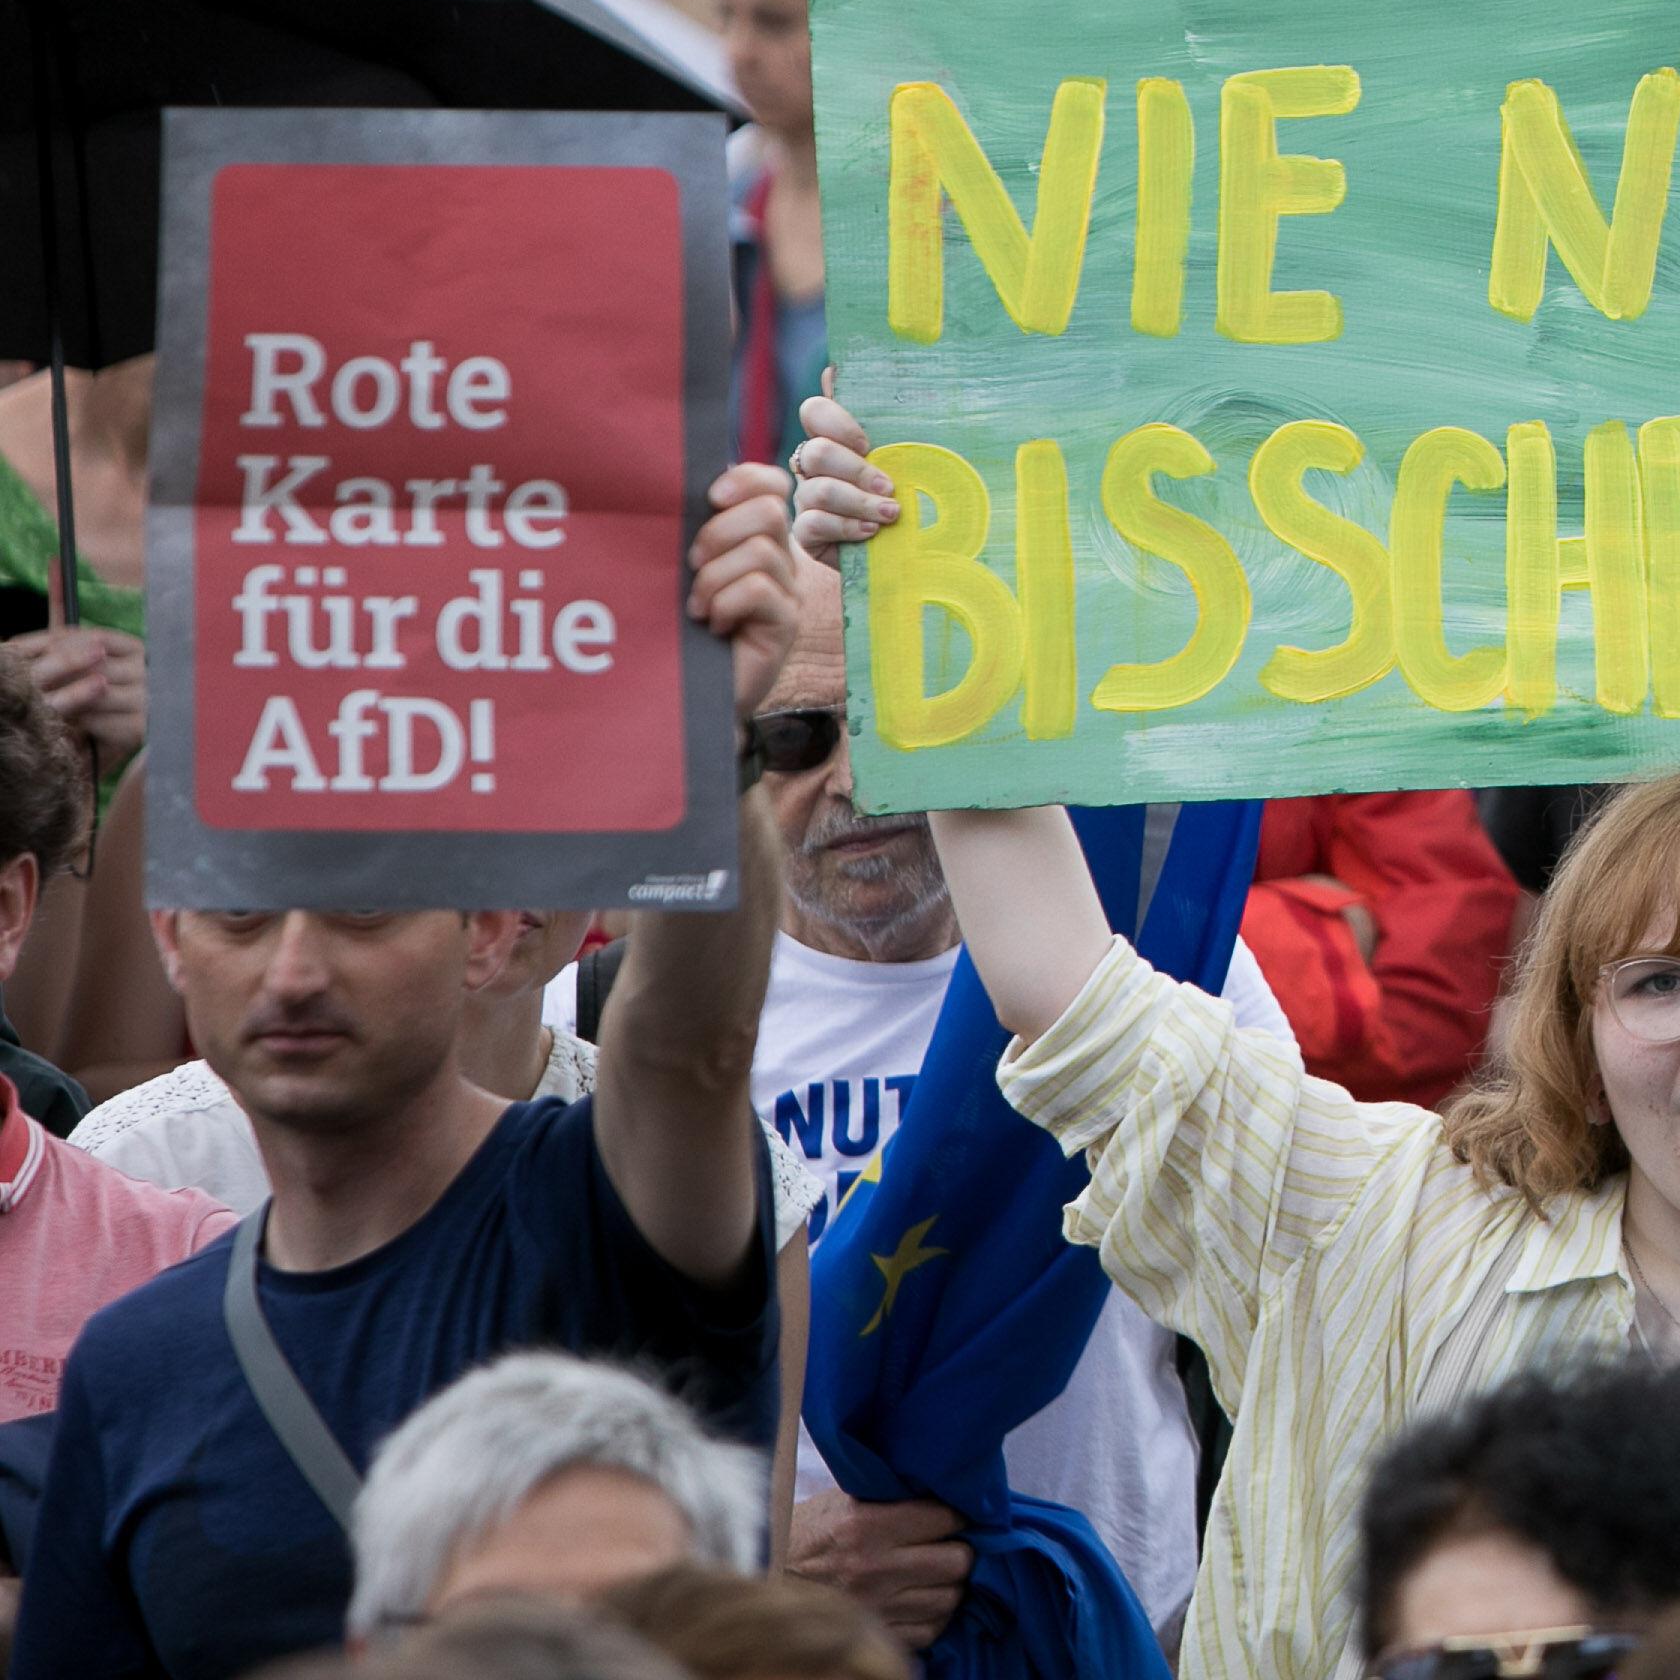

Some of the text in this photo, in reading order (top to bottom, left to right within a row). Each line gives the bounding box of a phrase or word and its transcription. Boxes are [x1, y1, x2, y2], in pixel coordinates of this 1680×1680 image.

[888, 65, 1361, 345] NIE
[239, 331, 512, 431] Rote
[230, 453, 569, 550] Karte
[231, 564, 616, 675] für die
[231, 689, 496, 795] AfD!
